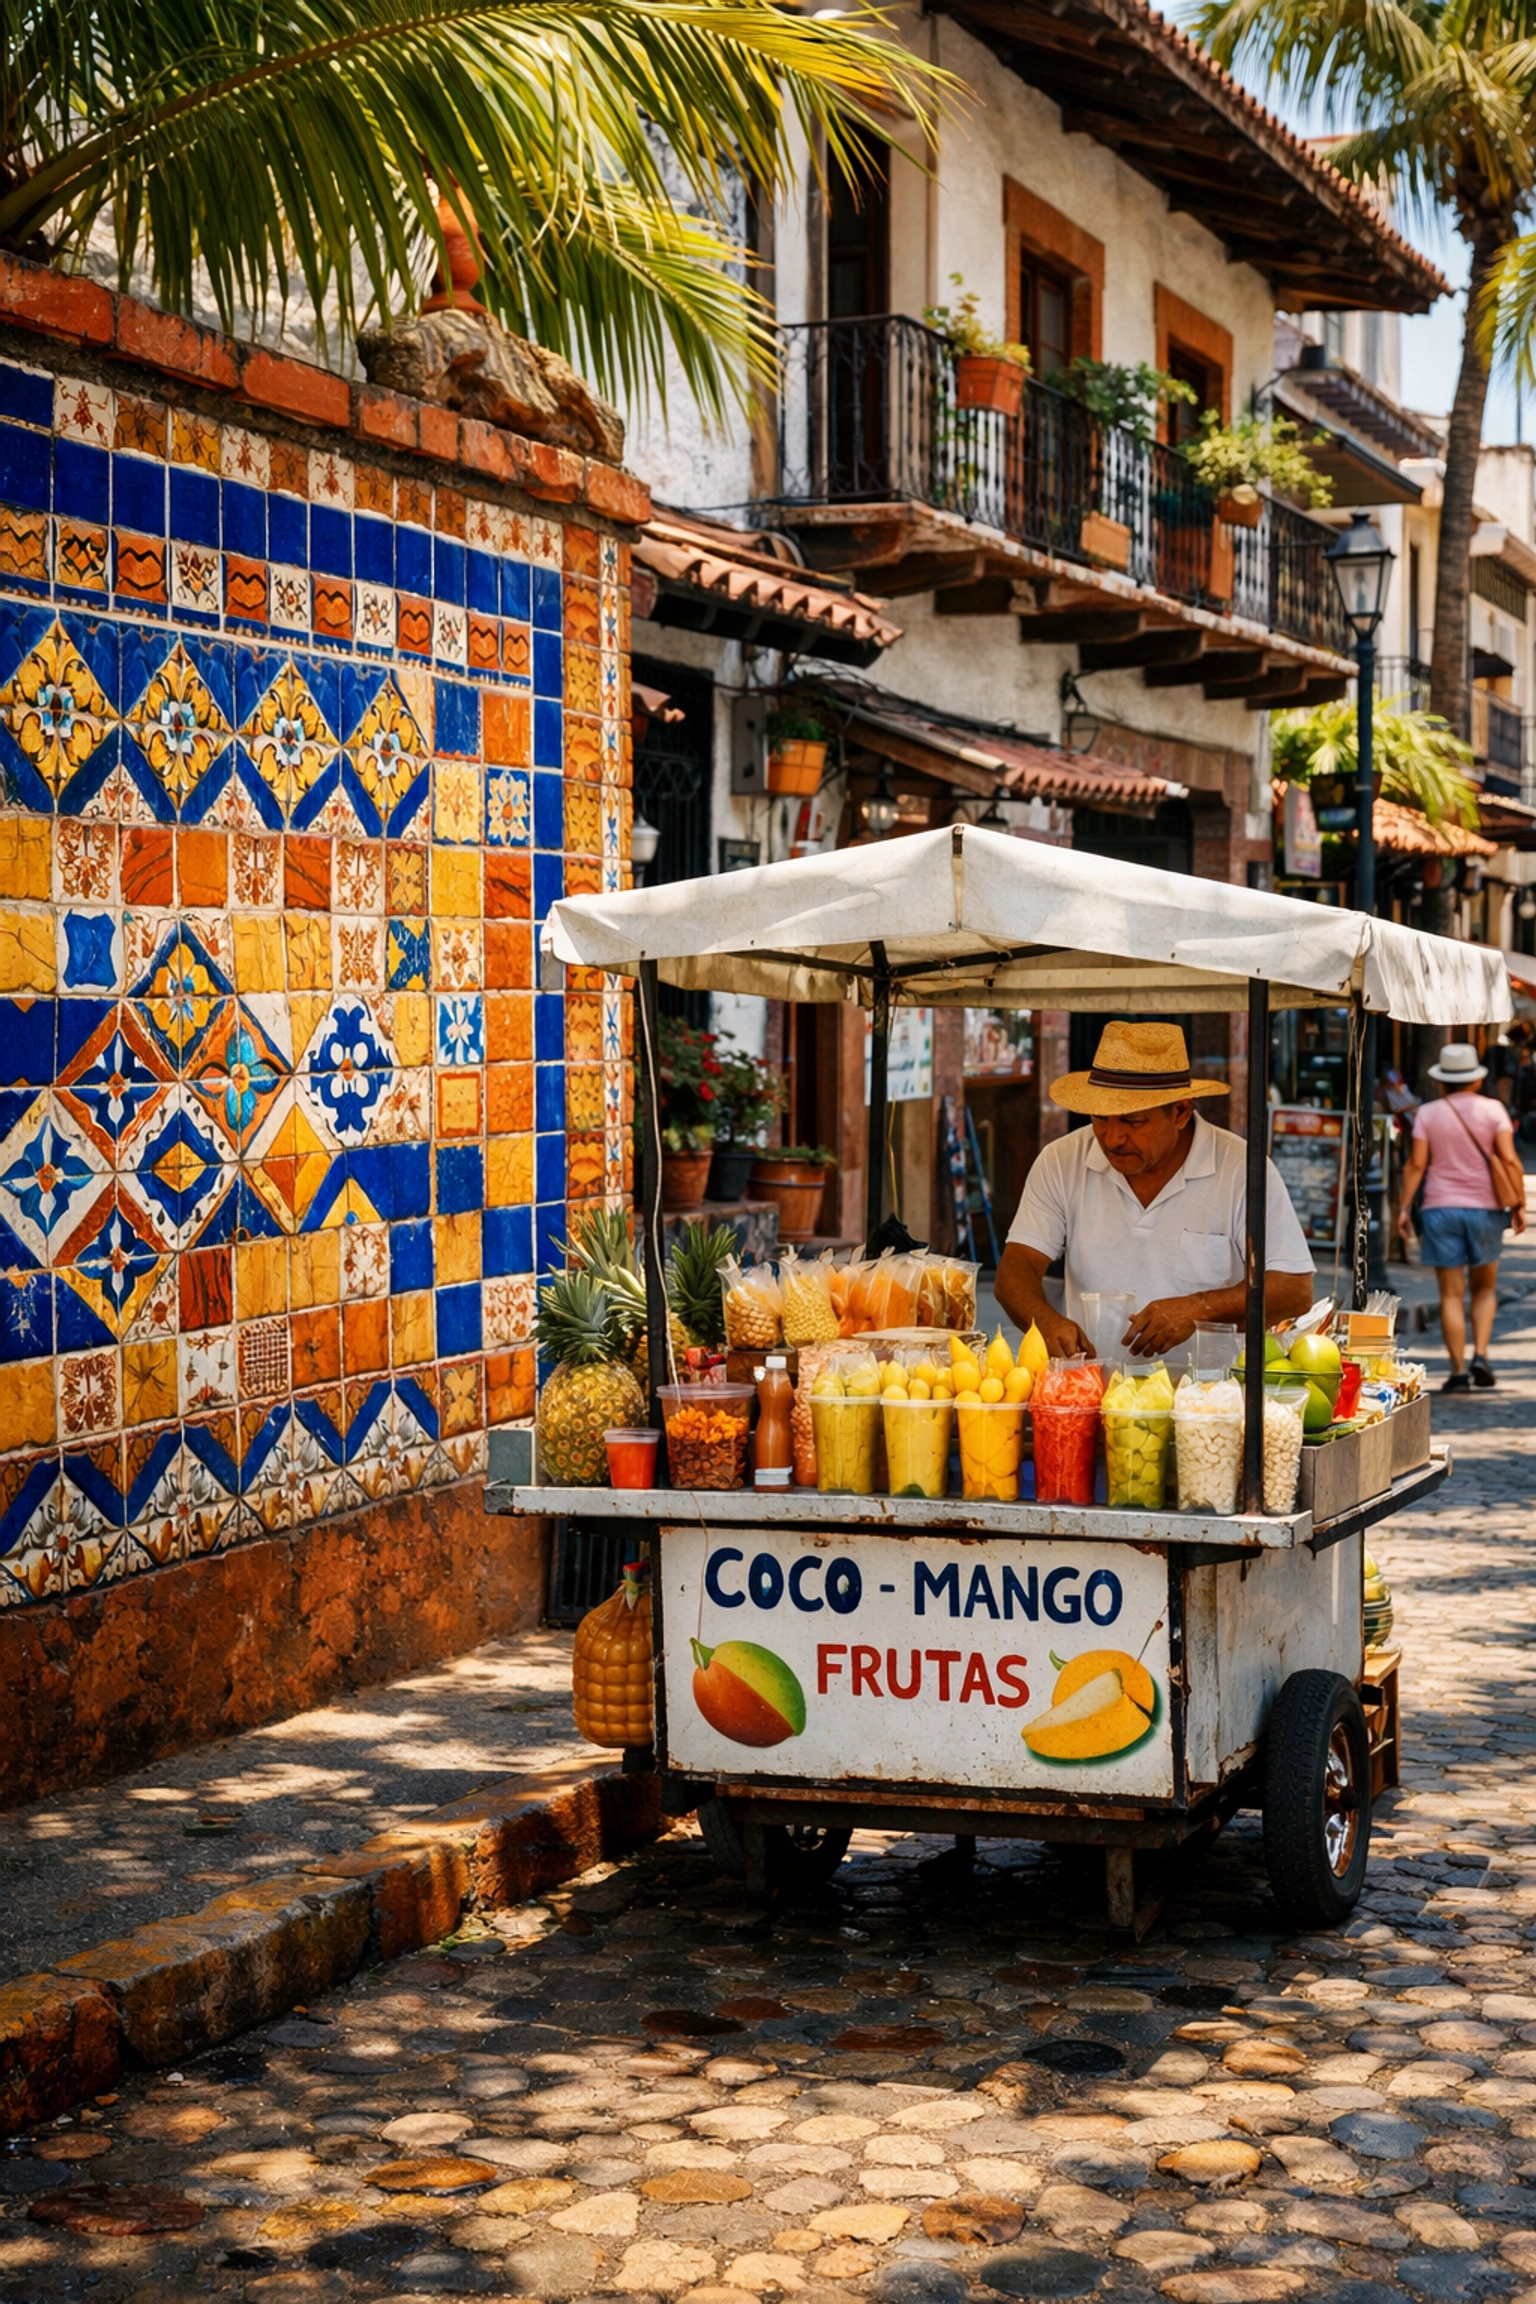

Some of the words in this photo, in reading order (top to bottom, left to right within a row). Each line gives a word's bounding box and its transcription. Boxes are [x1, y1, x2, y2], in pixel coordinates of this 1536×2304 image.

[705, 1547, 862, 1614] COCO
[880, 1584, 894, 1593] -
[914, 1561, 1123, 1627] MANGO
[817, 1643, 1031, 1709] FRUTAS
